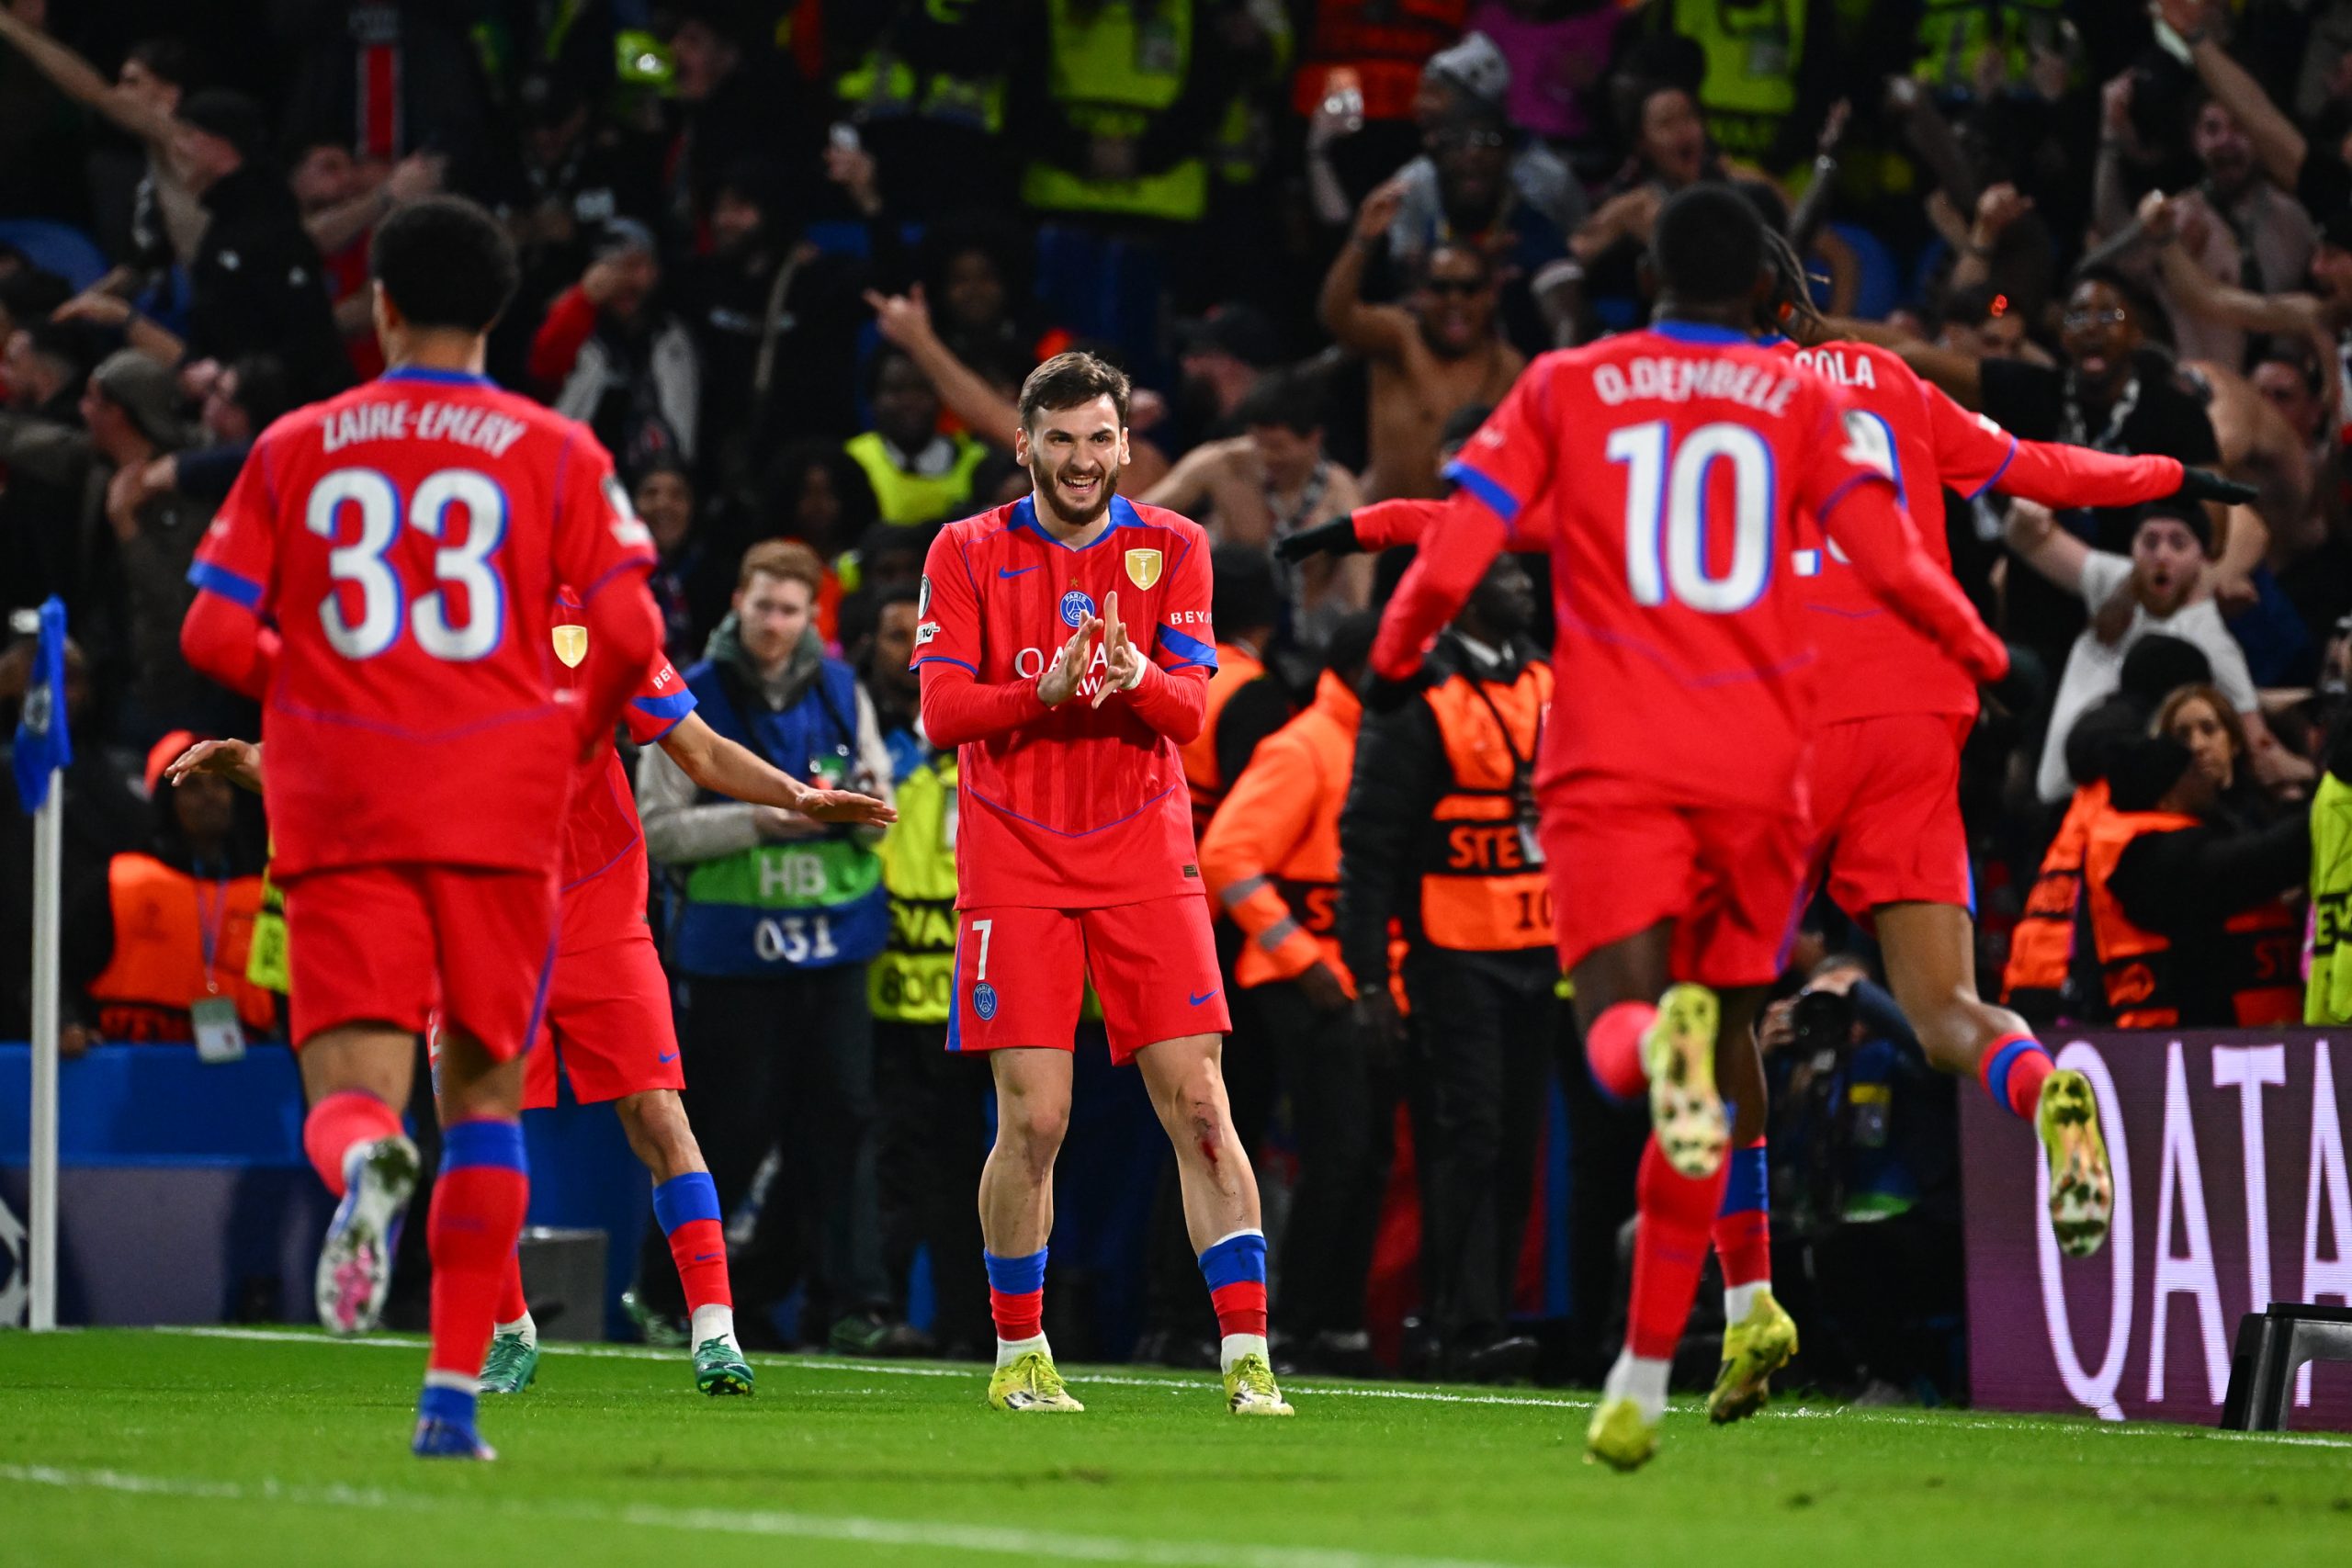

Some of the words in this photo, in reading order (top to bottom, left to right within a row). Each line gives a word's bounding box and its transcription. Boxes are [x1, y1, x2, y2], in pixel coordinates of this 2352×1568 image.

[1607, 419, 1777, 614] 10
[306, 467, 510, 661] 33
[1065, 593, 1087, 603] PARIS
[1014, 642, 1109, 678] QAA
[1448, 825, 1522, 869] STE
[760, 852, 826, 897] HB
[755, 916, 838, 962] 031
[972, 919, 992, 980] 7
